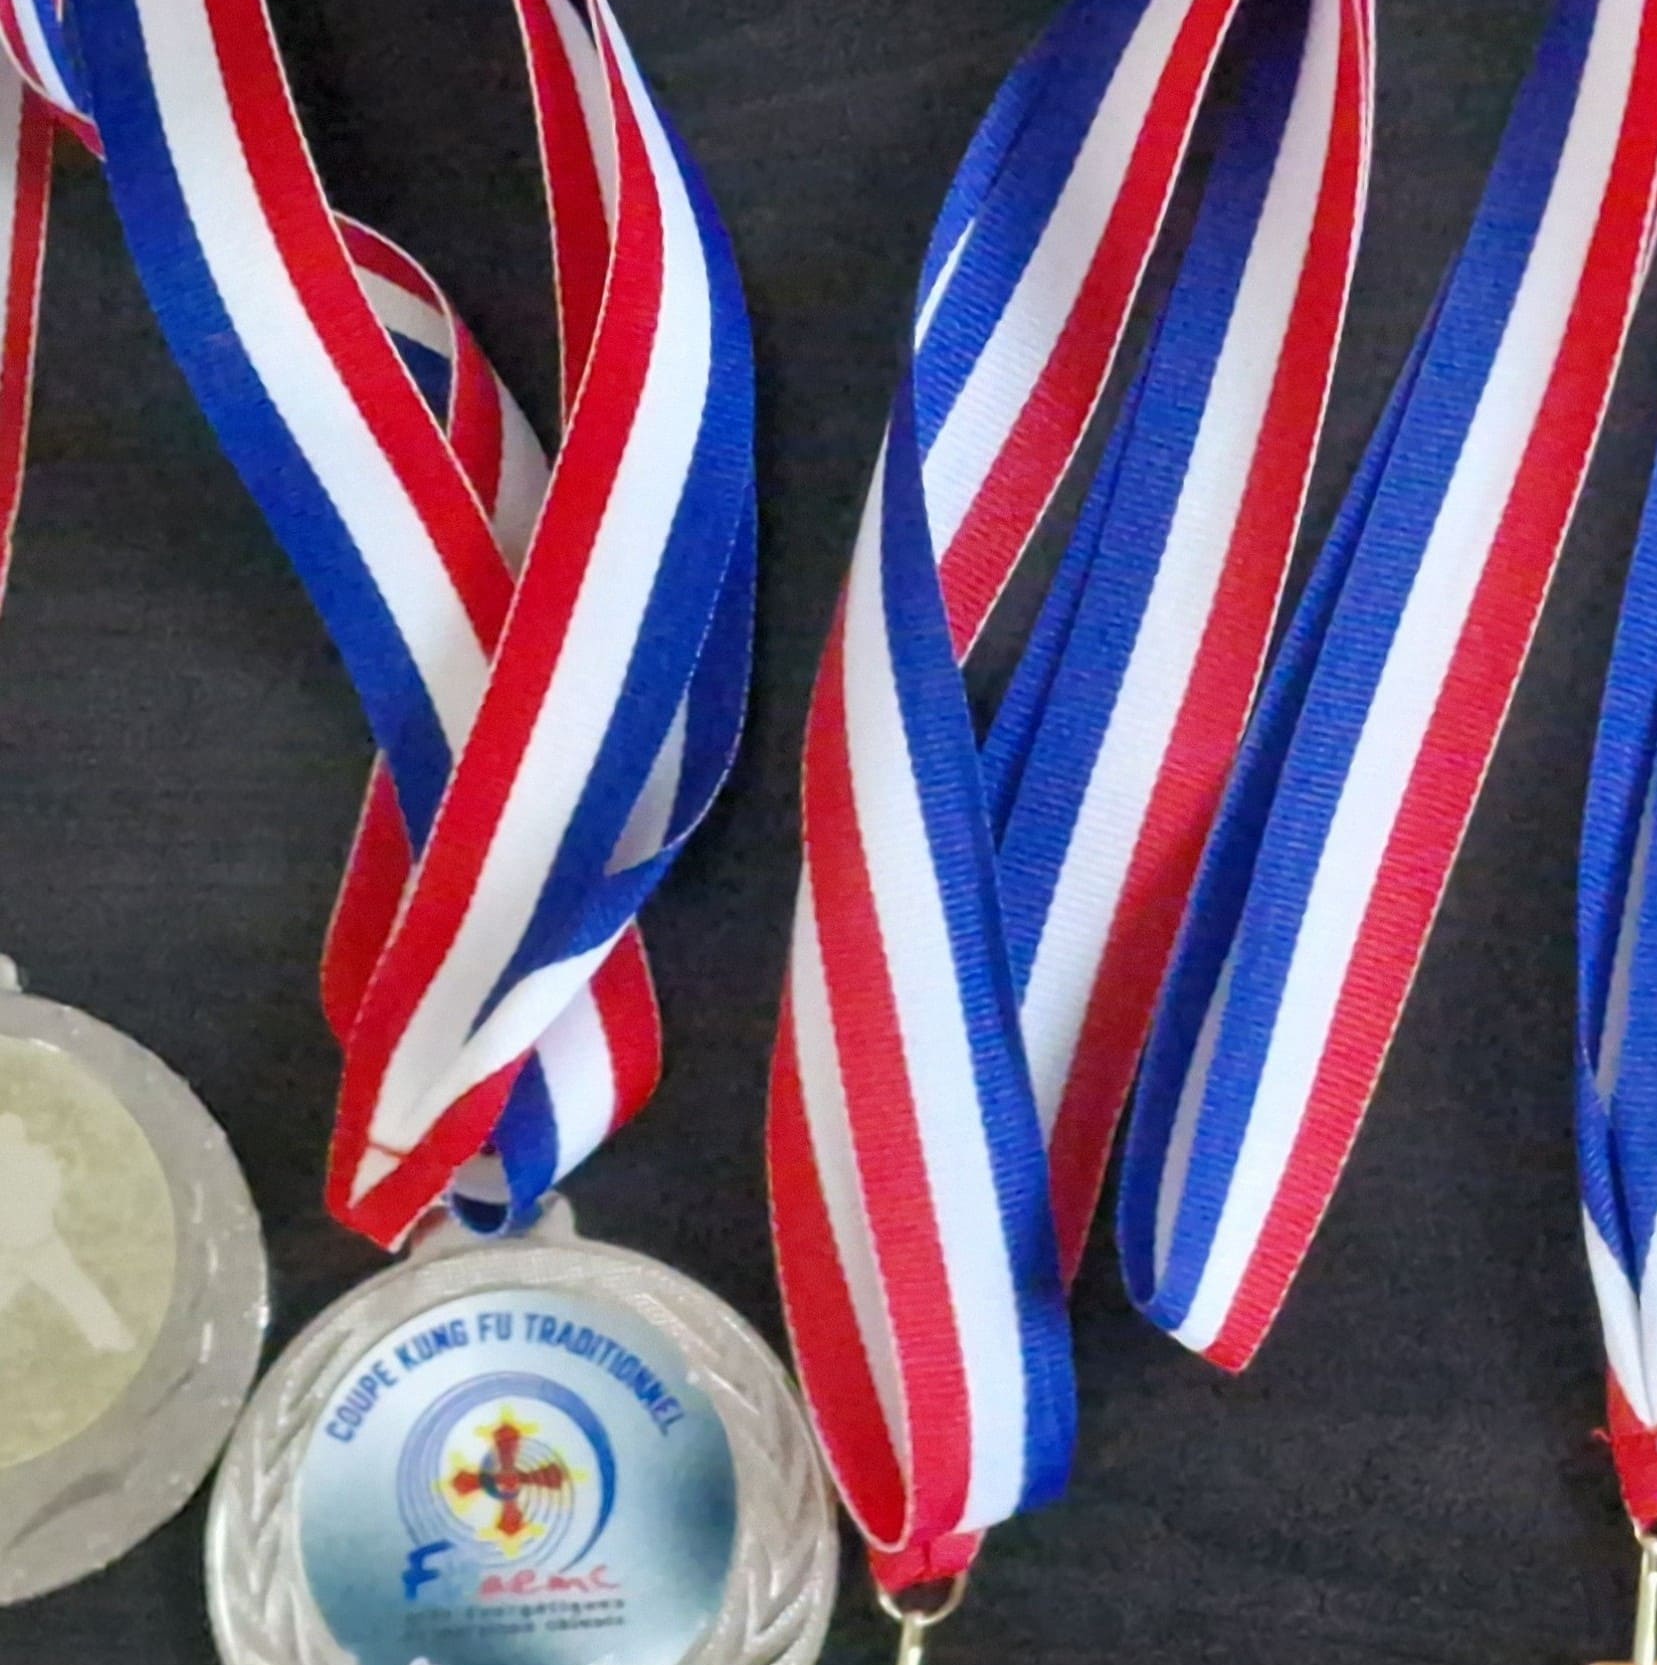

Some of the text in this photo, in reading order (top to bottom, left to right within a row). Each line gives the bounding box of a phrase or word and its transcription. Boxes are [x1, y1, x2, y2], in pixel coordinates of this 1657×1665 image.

[324, 1312, 687, 1443] COUPE KUNG FU TRADITIONNEL
